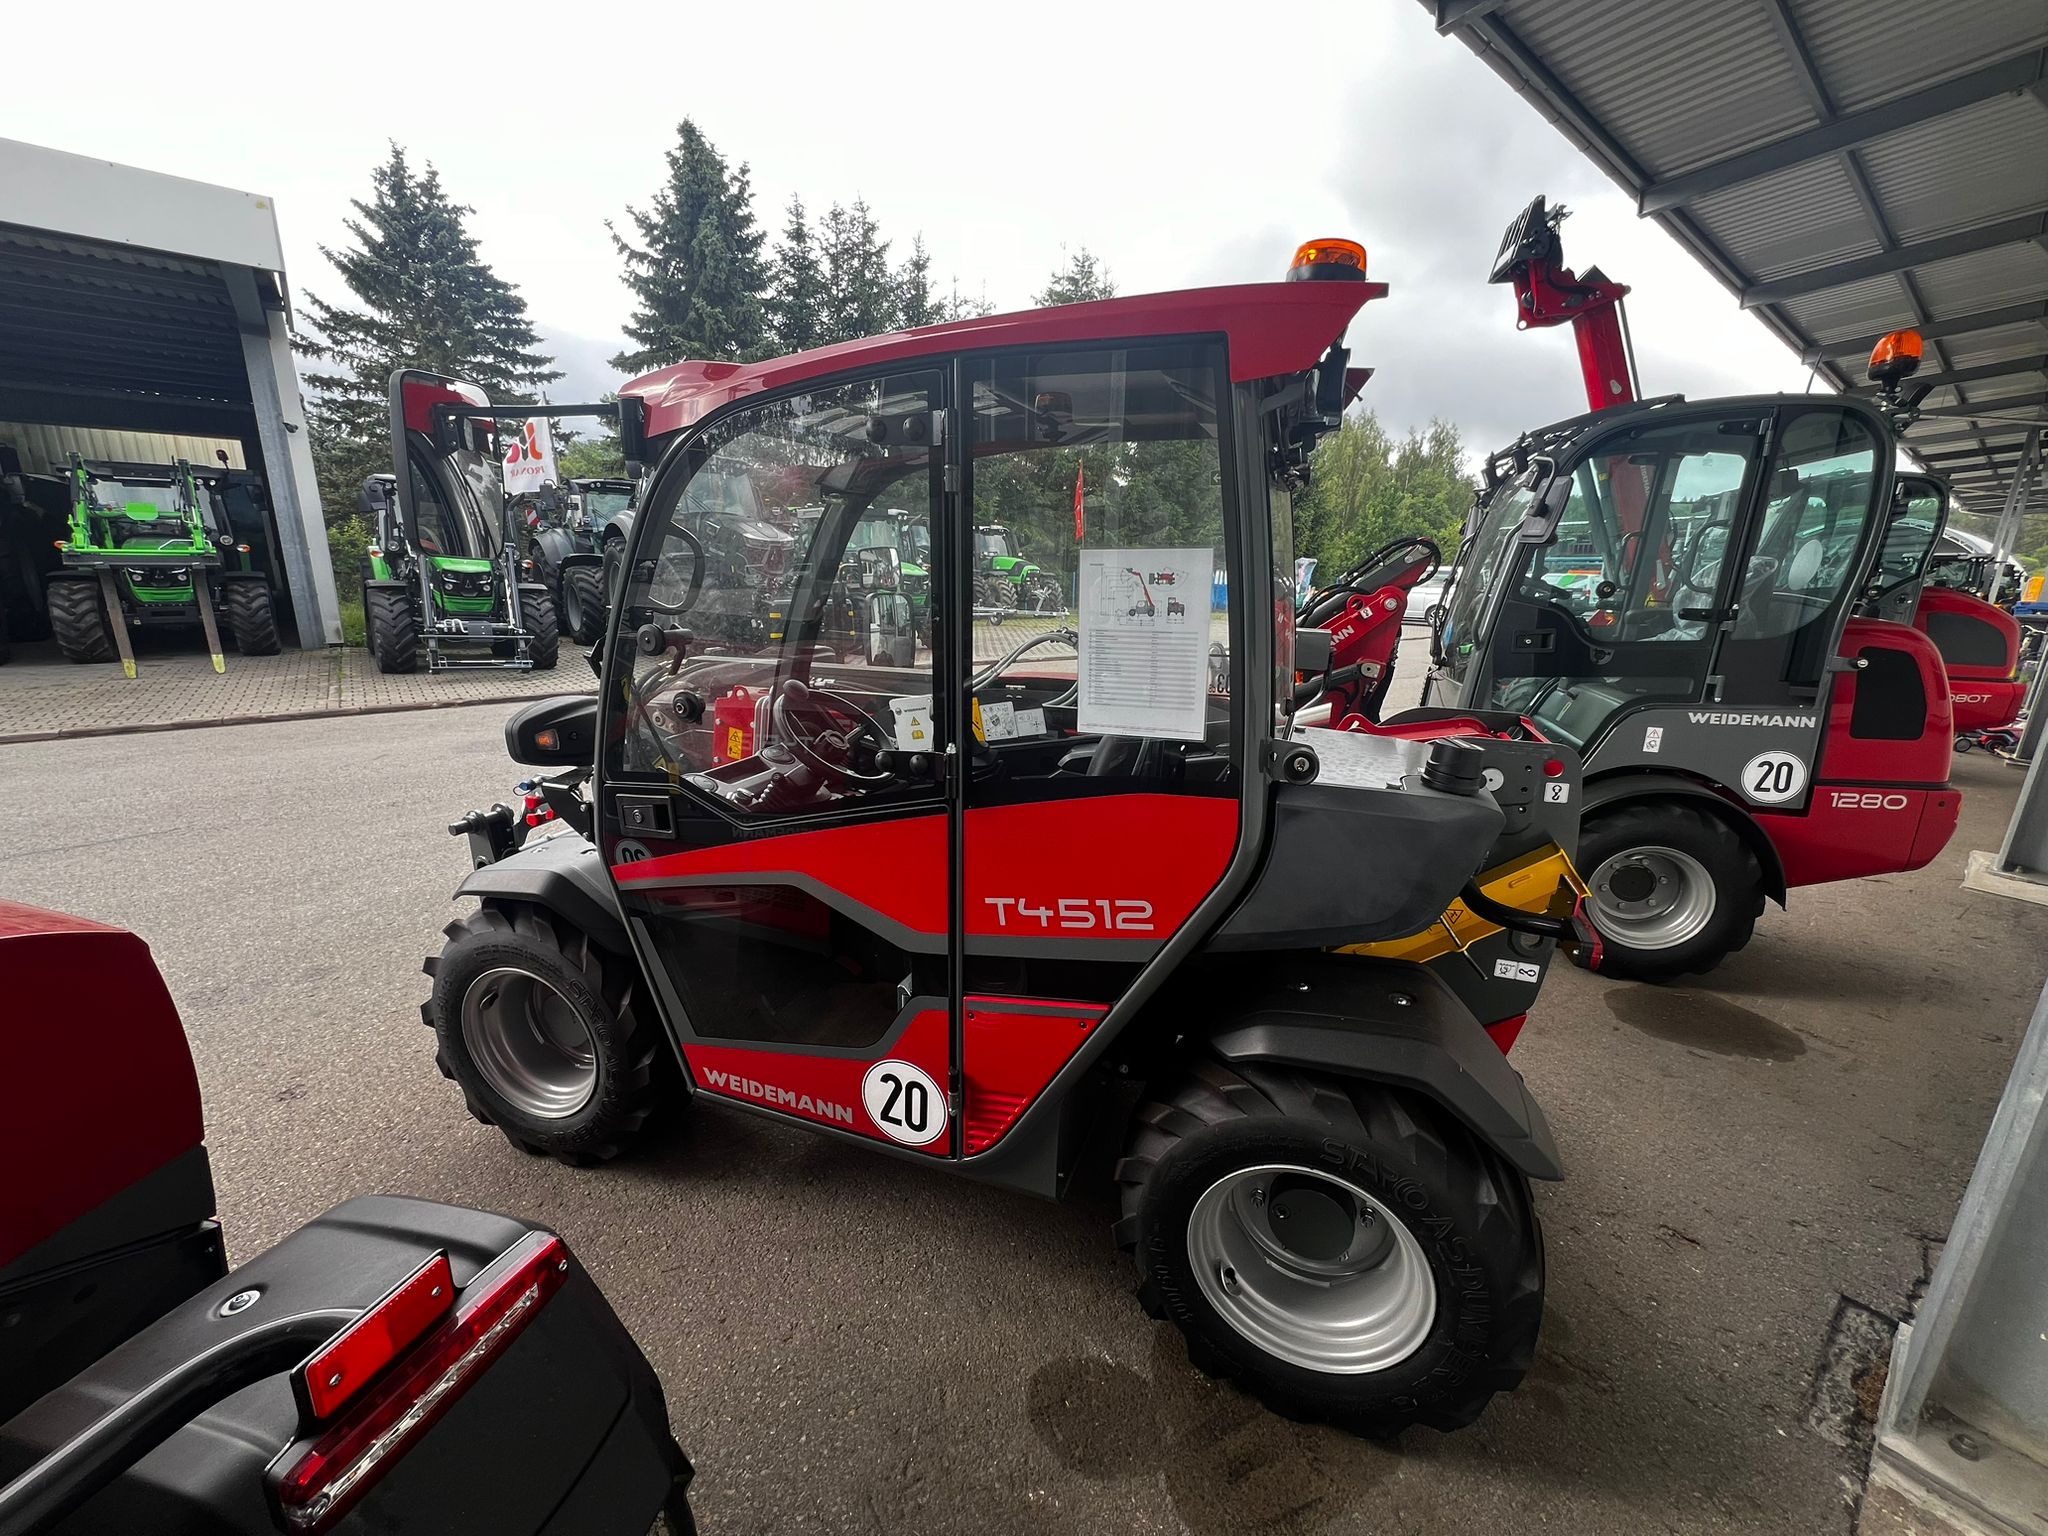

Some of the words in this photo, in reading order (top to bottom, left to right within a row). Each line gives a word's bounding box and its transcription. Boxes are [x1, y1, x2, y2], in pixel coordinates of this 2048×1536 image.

[1688, 712, 1817, 728] WEIDEMANN
[1753, 760, 1794, 794] 20
[1830, 792, 1908, 810] 1280
[984, 897, 1154, 931] T4512
[702, 1066, 854, 1124] WEIDEMANN
[880, 1072, 929, 1133] 20
